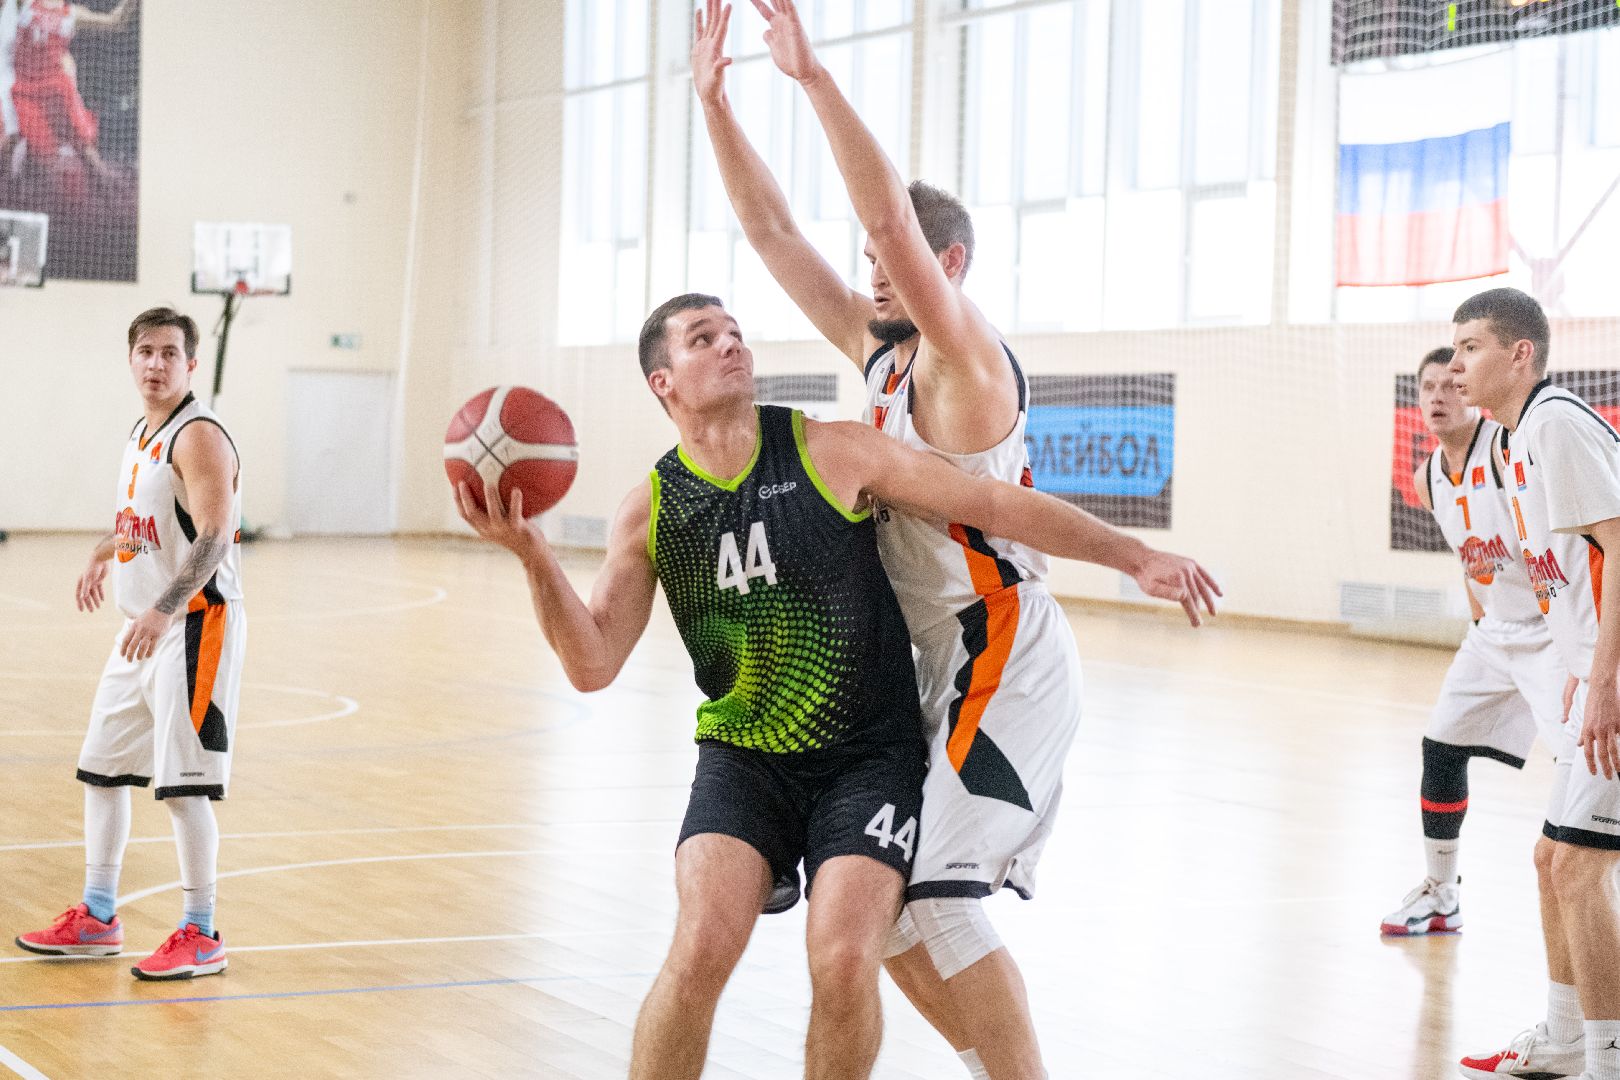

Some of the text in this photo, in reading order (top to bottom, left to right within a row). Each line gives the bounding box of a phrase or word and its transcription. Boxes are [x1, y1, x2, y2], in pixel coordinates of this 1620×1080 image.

[1024, 420, 1162, 478] ОЛЕЙБОЛ
[1455, 495, 1472, 531] 1
[1511, 495, 1528, 541] 11
[716, 521, 778, 595] 44
[864, 803, 918, 863] 44
